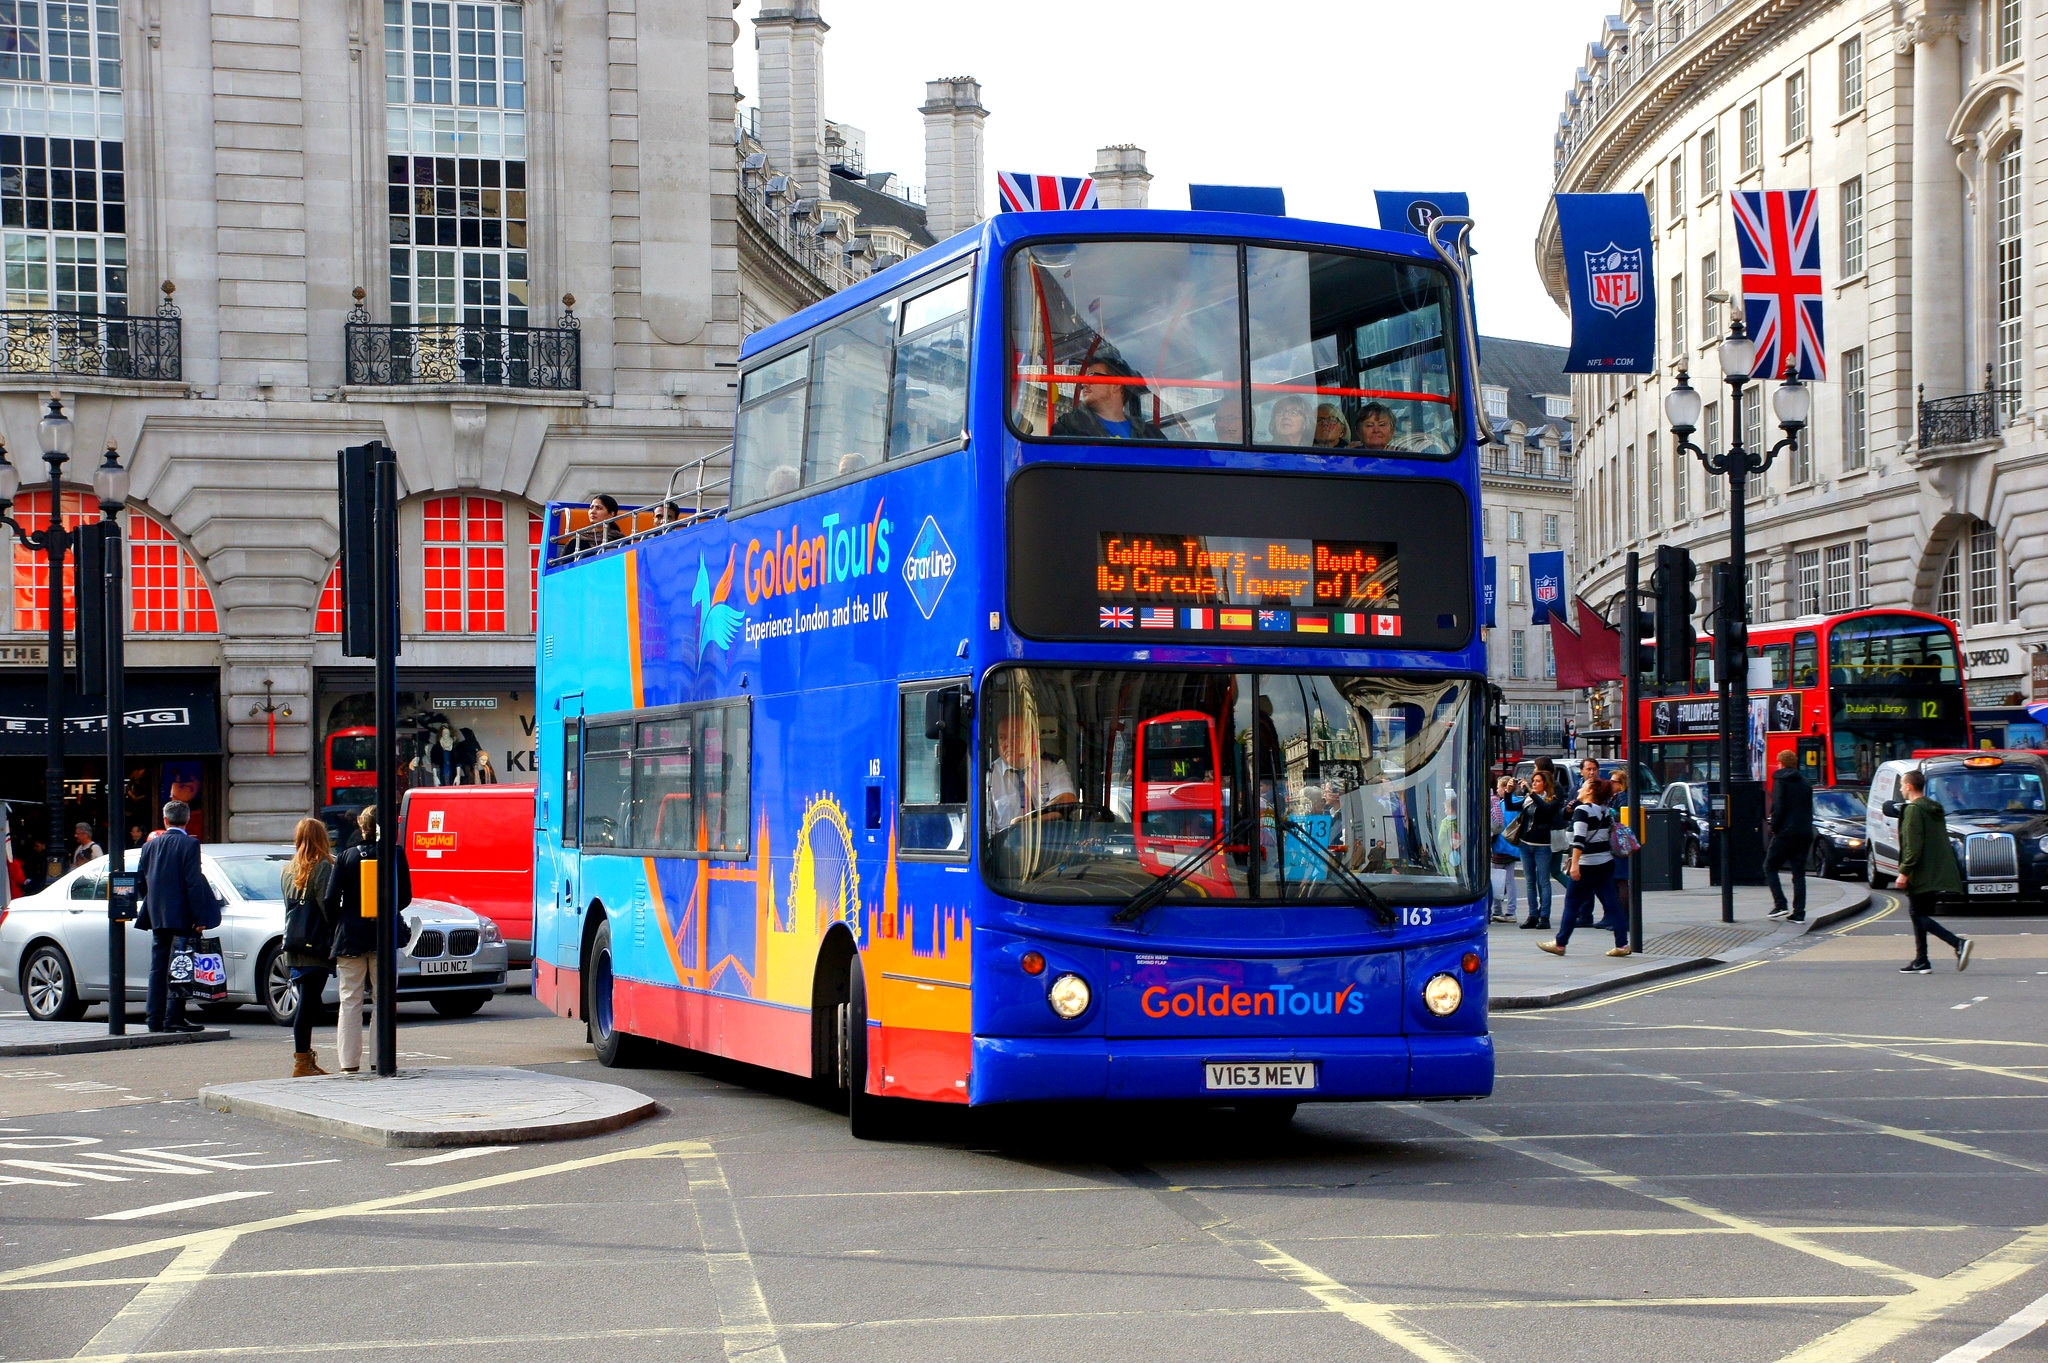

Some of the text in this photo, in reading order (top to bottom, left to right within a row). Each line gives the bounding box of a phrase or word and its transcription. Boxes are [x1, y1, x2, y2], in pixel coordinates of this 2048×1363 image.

[1416, 207, 1433, 227] R
[1594, 274, 1637, 307] NFL
[744, 496, 891, 605] GoldenTours
[1108, 539, 1177, 567] Golden
[1183, 541, 1247, 569] Tours
[1268, 544, 1311, 571] Blue
[1316, 546, 1379, 573] Route
[1132, 566, 1224, 595] Circus,
[1232, 569, 1309, 596] Tower
[1316, 572, 1343, 598] of
[1537, 587, 1556, 600] NFL
[745, 590, 889, 649] Experience London and the UK
[0, 648, 40, 659] THE
[1846, 704, 1907, 716] Dulwich Library
[1922, 702, 1938, 718] 12
[869, 758, 880, 776] 163
[1307, 820, 1327, 837] 13
[416, 834, 454, 848] Royal Mail
[1973, 883, 2013, 893] KE12 LZP
[1402, 907, 1432, 926] 163
[426, 960, 469, 974] LL10 NCZ
[1141, 982, 1365, 1018] GoldenTours
[1212, 1067, 1307, 1086] V163 MEV
